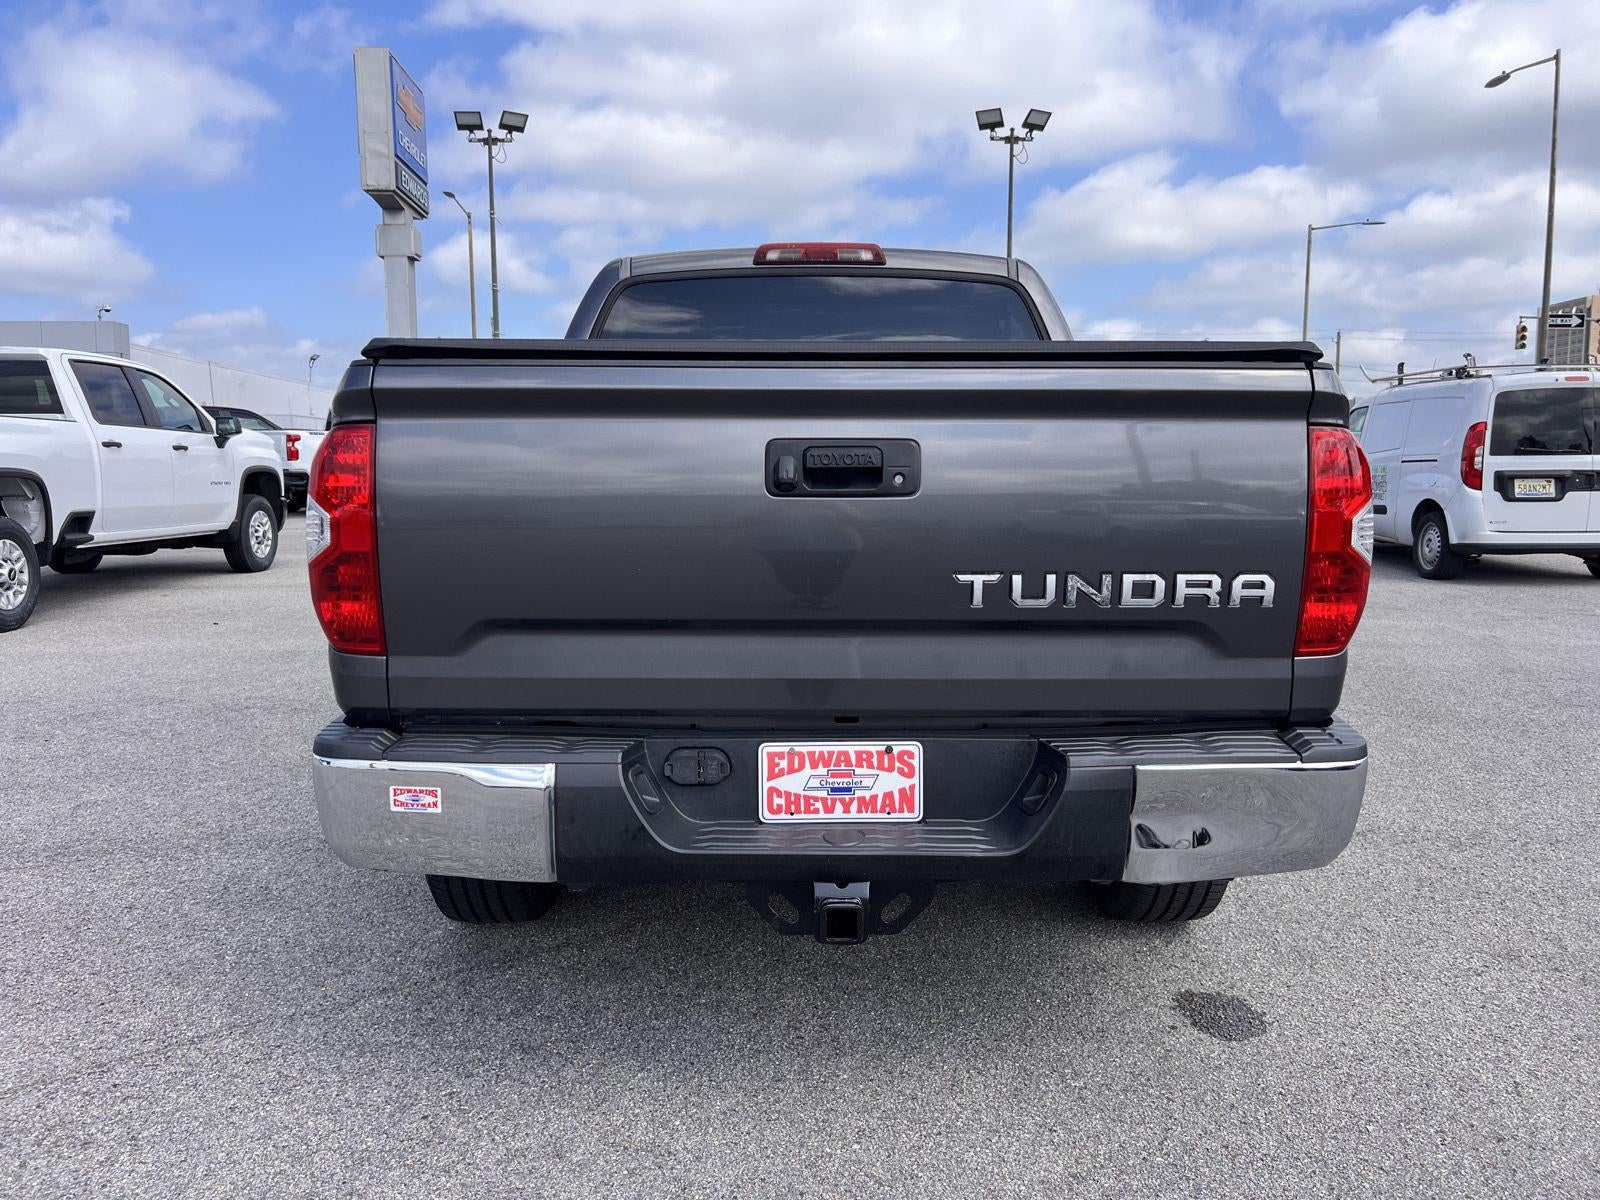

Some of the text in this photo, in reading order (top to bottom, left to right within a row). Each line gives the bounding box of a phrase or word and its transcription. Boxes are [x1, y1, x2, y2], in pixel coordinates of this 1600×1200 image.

[398, 130, 426, 167] CHEVROLET
[401, 170, 428, 207] EDWARDS
[810, 453, 877, 466] TOYOTA
[1517, 484, 1552, 493] 58AN2M7
[952, 572, 1277, 609] TUNDRA
[767, 749, 916, 783] EDWARDS
[393, 788, 438, 799] EDWARDS
[819, 778, 863, 787] Chevrolet
[393, 798, 438, 808] CHEVYMAN
[767, 783, 916, 815] CHEVYMAN
